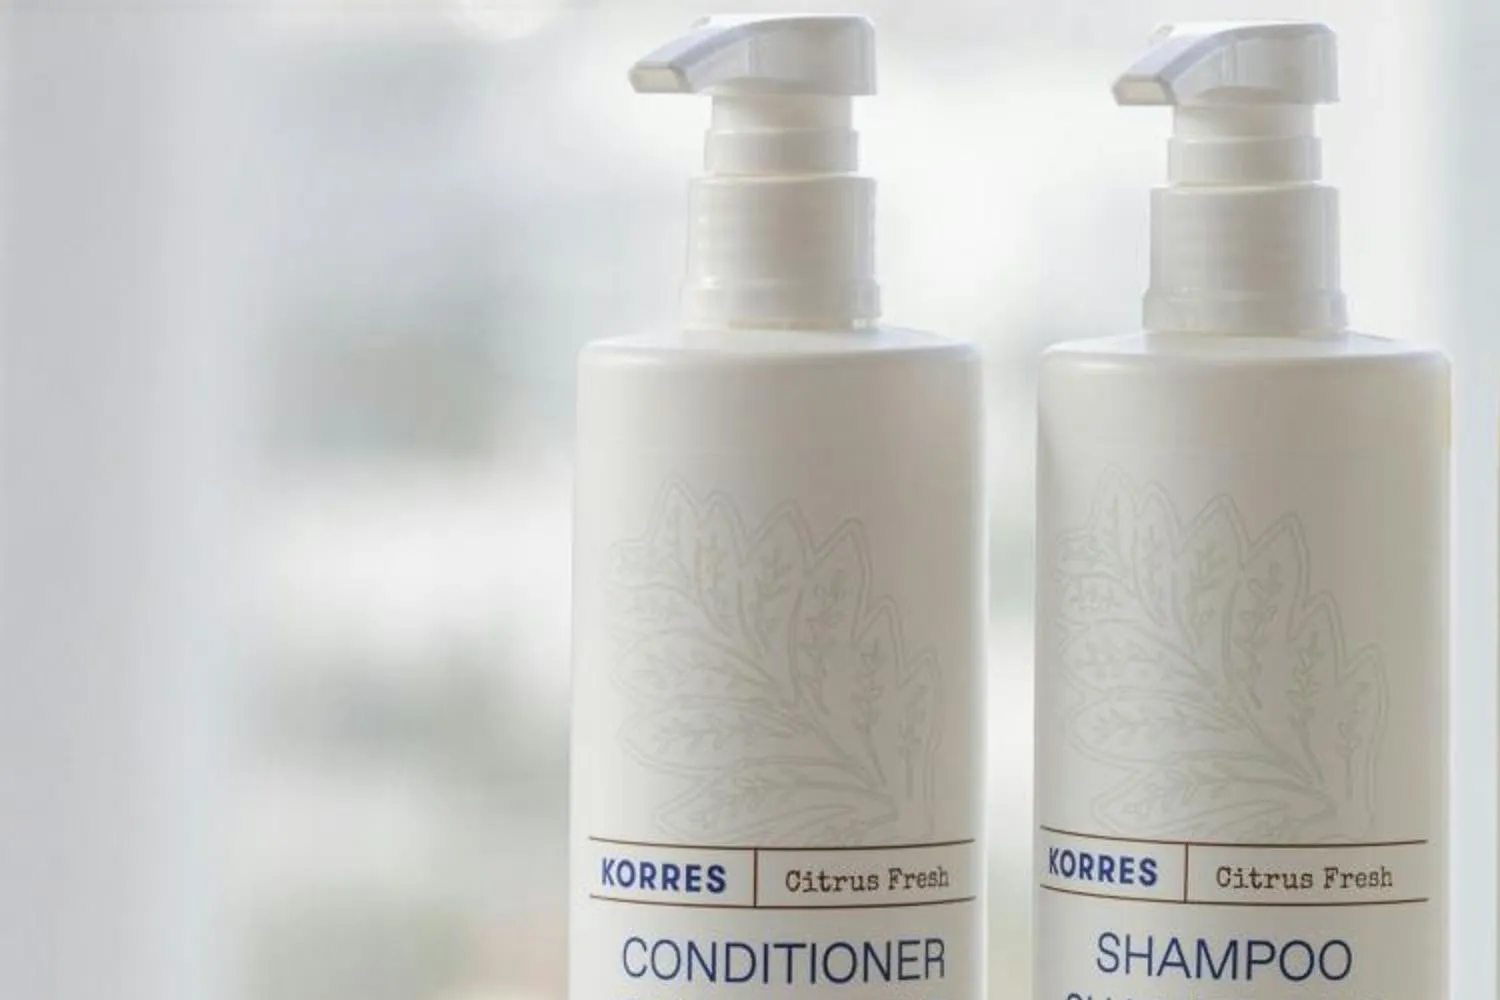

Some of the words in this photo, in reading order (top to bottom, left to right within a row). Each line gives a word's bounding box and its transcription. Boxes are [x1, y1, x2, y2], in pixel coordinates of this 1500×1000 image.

[602, 858, 726, 893] KORRES
[786, 870, 879, 893] Citrus
[888, 866, 949, 890] Fresh
[1048, 847, 1158, 887] KORRES
[1216, 866, 1313, 890] Citrus
[1324, 866, 1392, 889] Fresh
[623, 937, 944, 984] CONDITIONER
[1097, 932, 1352, 981] SHAMPOO
